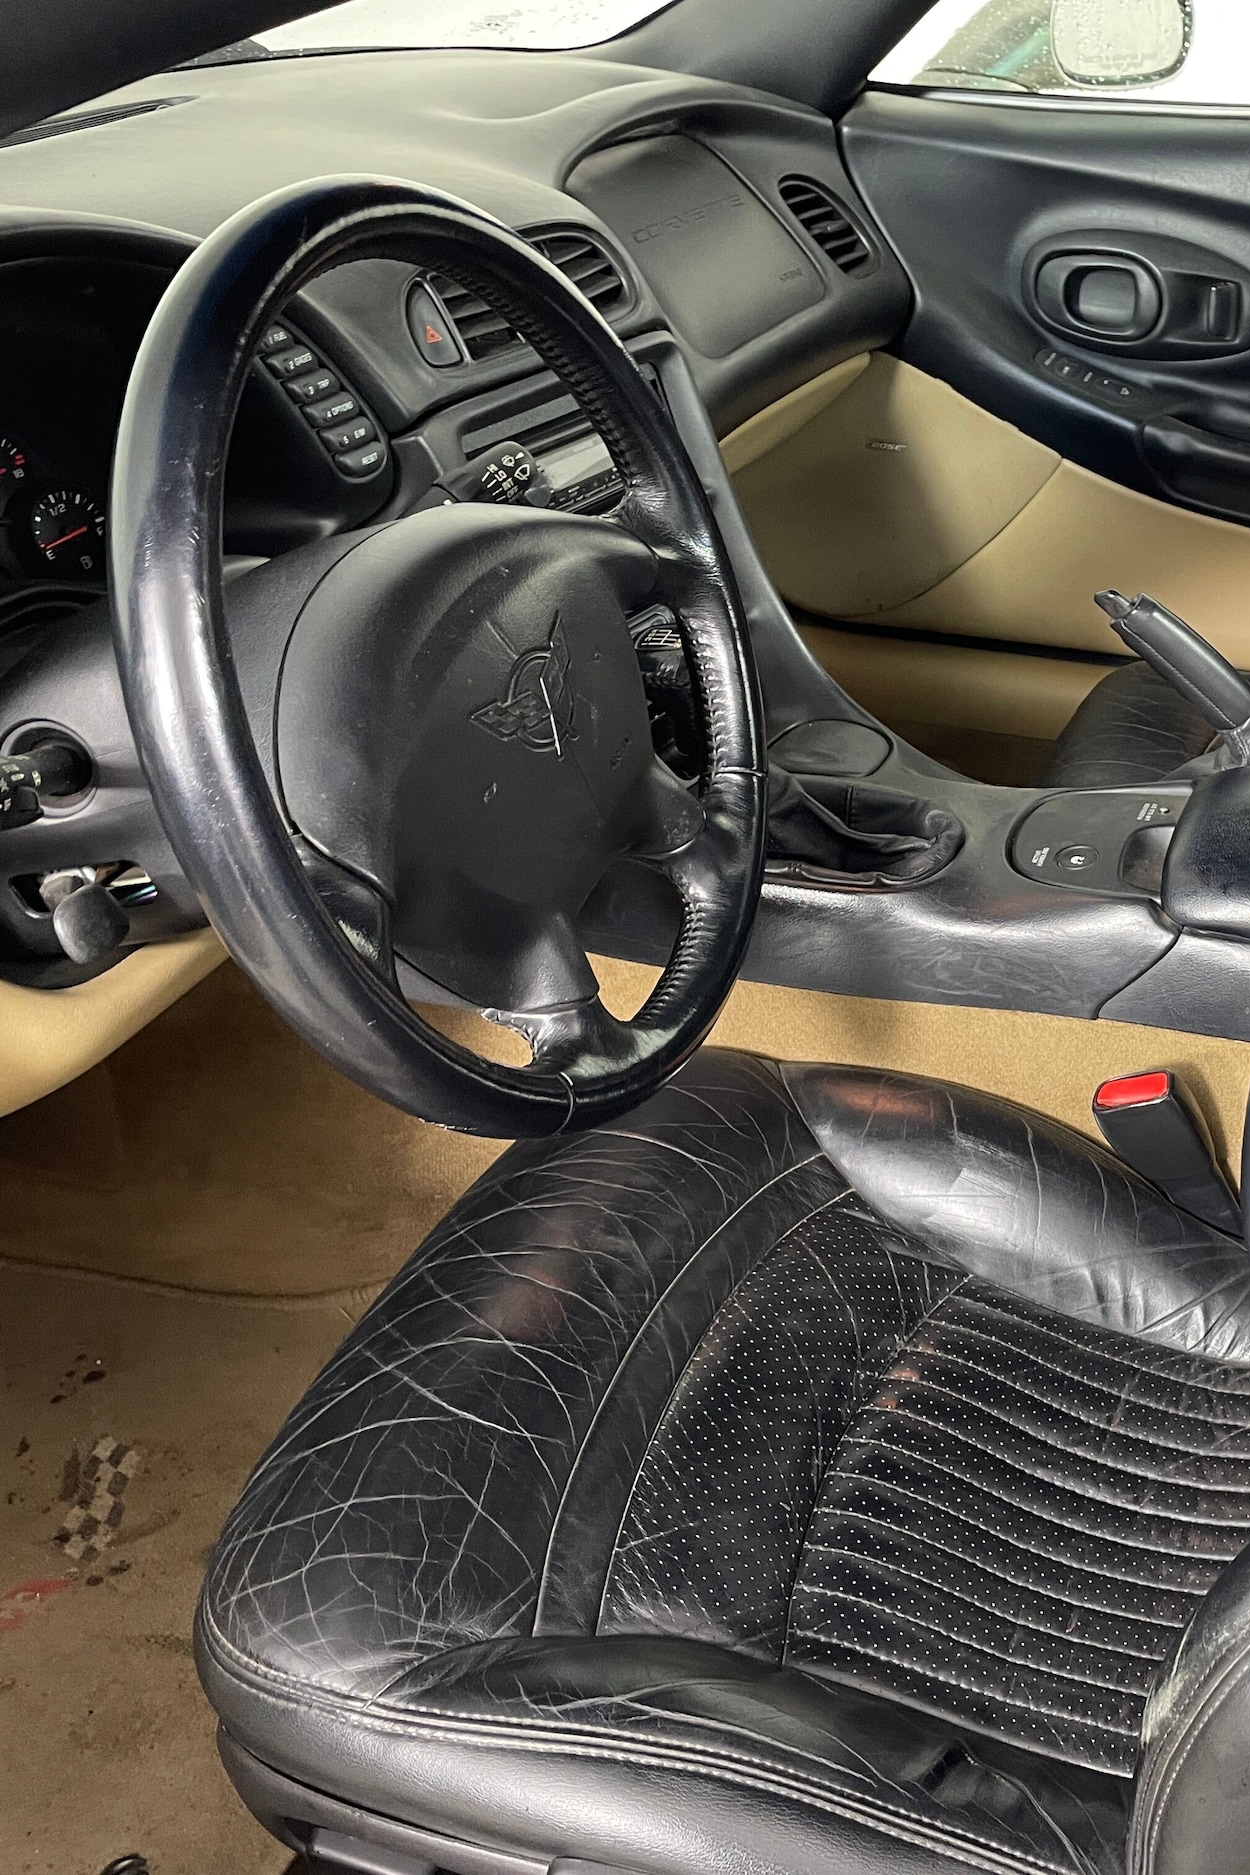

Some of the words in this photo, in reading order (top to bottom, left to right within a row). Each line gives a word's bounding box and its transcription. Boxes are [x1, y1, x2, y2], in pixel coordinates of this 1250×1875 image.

[288, 360, 295, 370] 2
[343, 435, 349, 445] 5
[494, 470, 507, 481] LO
[501, 477, 514, 491] INT
[45, 549, 57, 561] E
